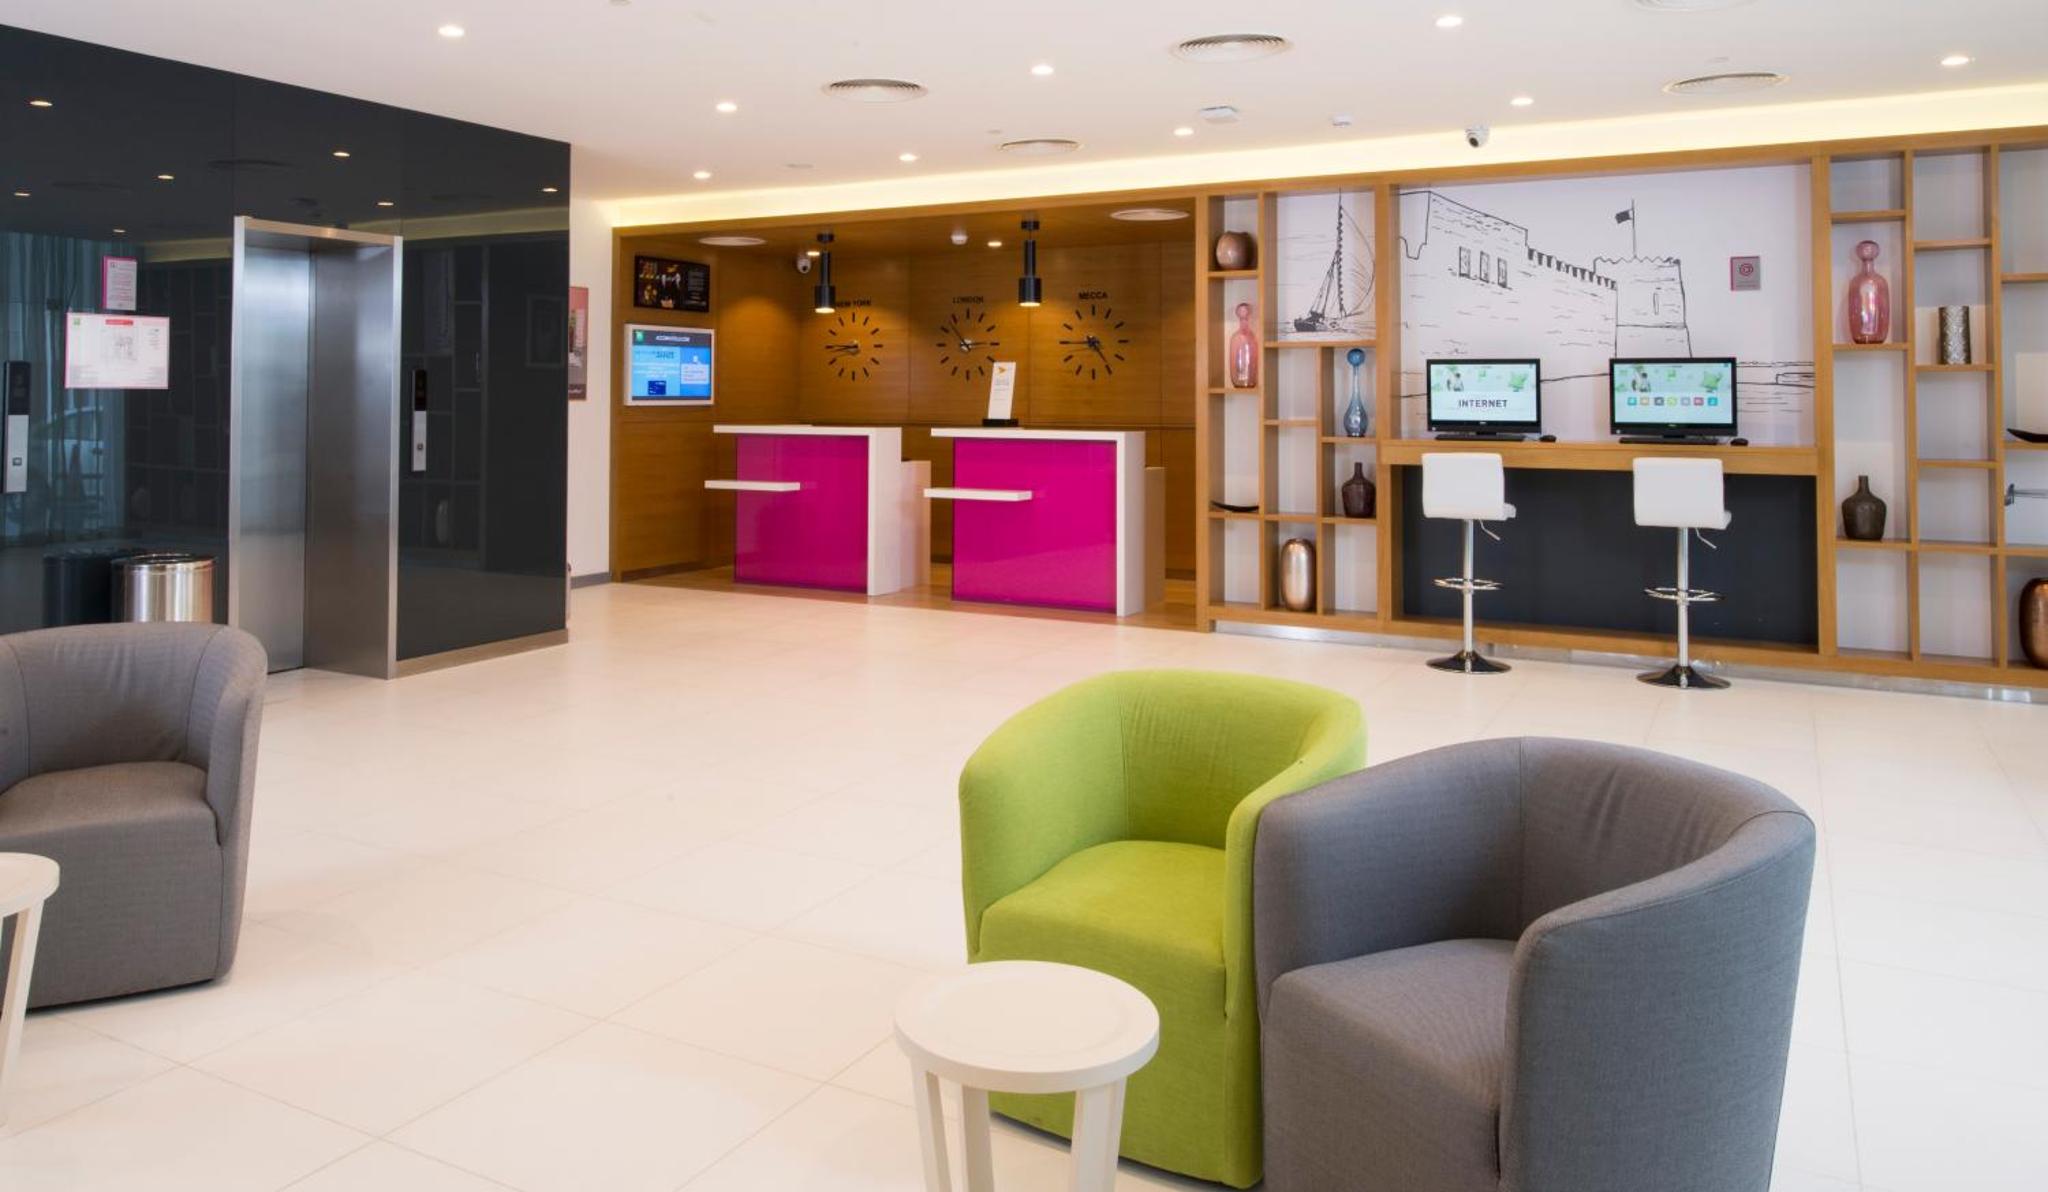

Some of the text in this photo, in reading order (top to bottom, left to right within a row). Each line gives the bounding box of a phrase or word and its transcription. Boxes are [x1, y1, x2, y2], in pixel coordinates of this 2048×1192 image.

[952, 295, 984, 304] LONDON
[1078, 291, 1108, 300] MECCA
[1458, 399, 1508, 408] INTERNET
